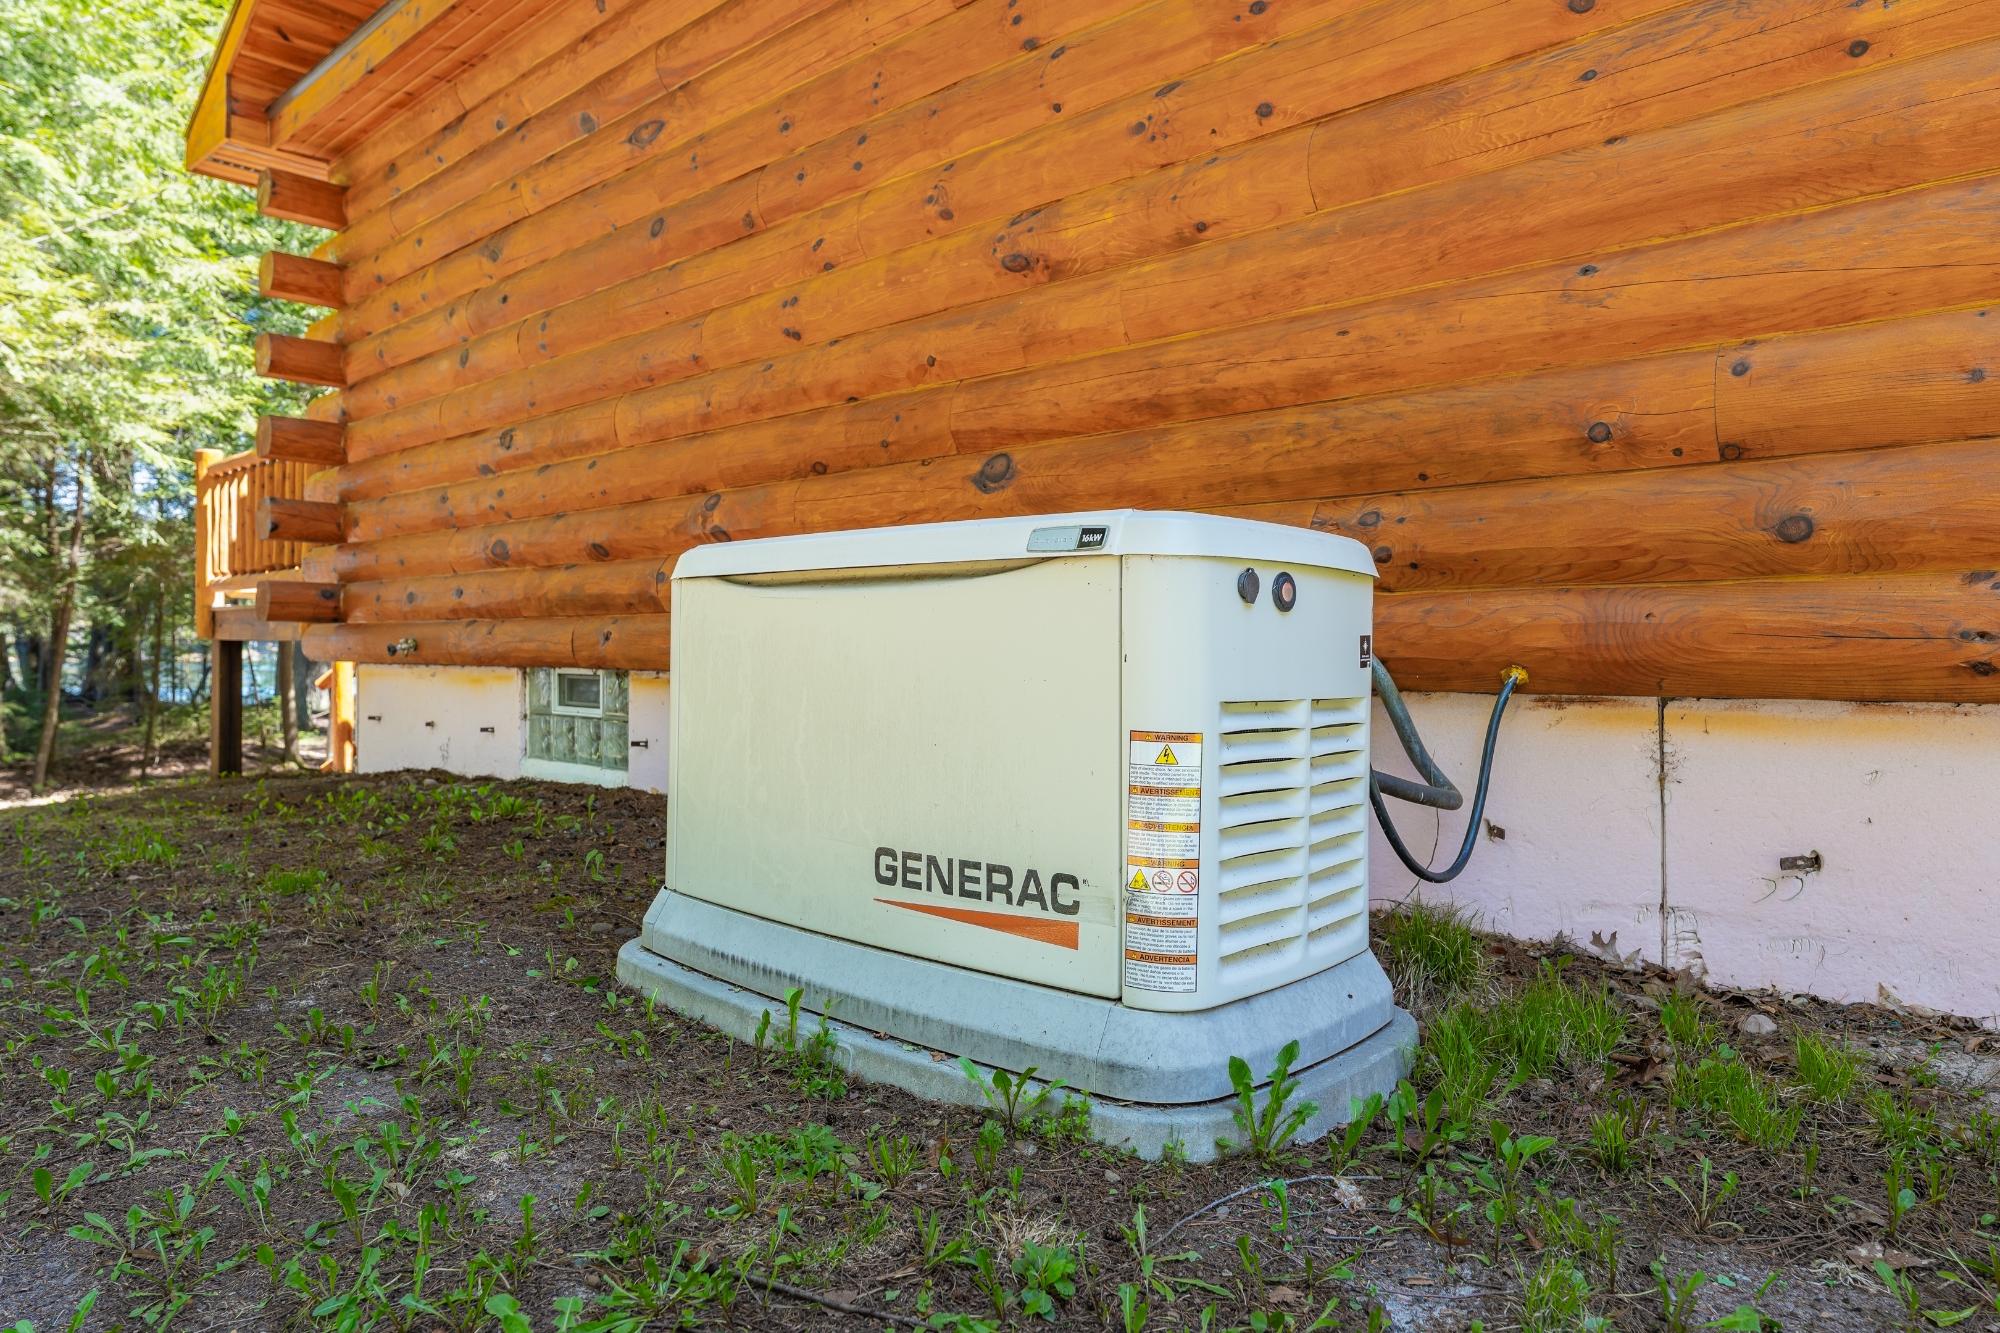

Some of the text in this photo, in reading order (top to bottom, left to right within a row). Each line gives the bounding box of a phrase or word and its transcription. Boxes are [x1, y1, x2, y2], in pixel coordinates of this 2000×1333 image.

[1081, 533, 1102, 542] 16kW
[1154, 734, 1189, 742] WARNING
[874, 846, 1081, 916] GENERAC
[1136, 916, 1196, 927] AVERTISSEMENT
[1139, 954, 1190, 963] ADVERTENCIA
